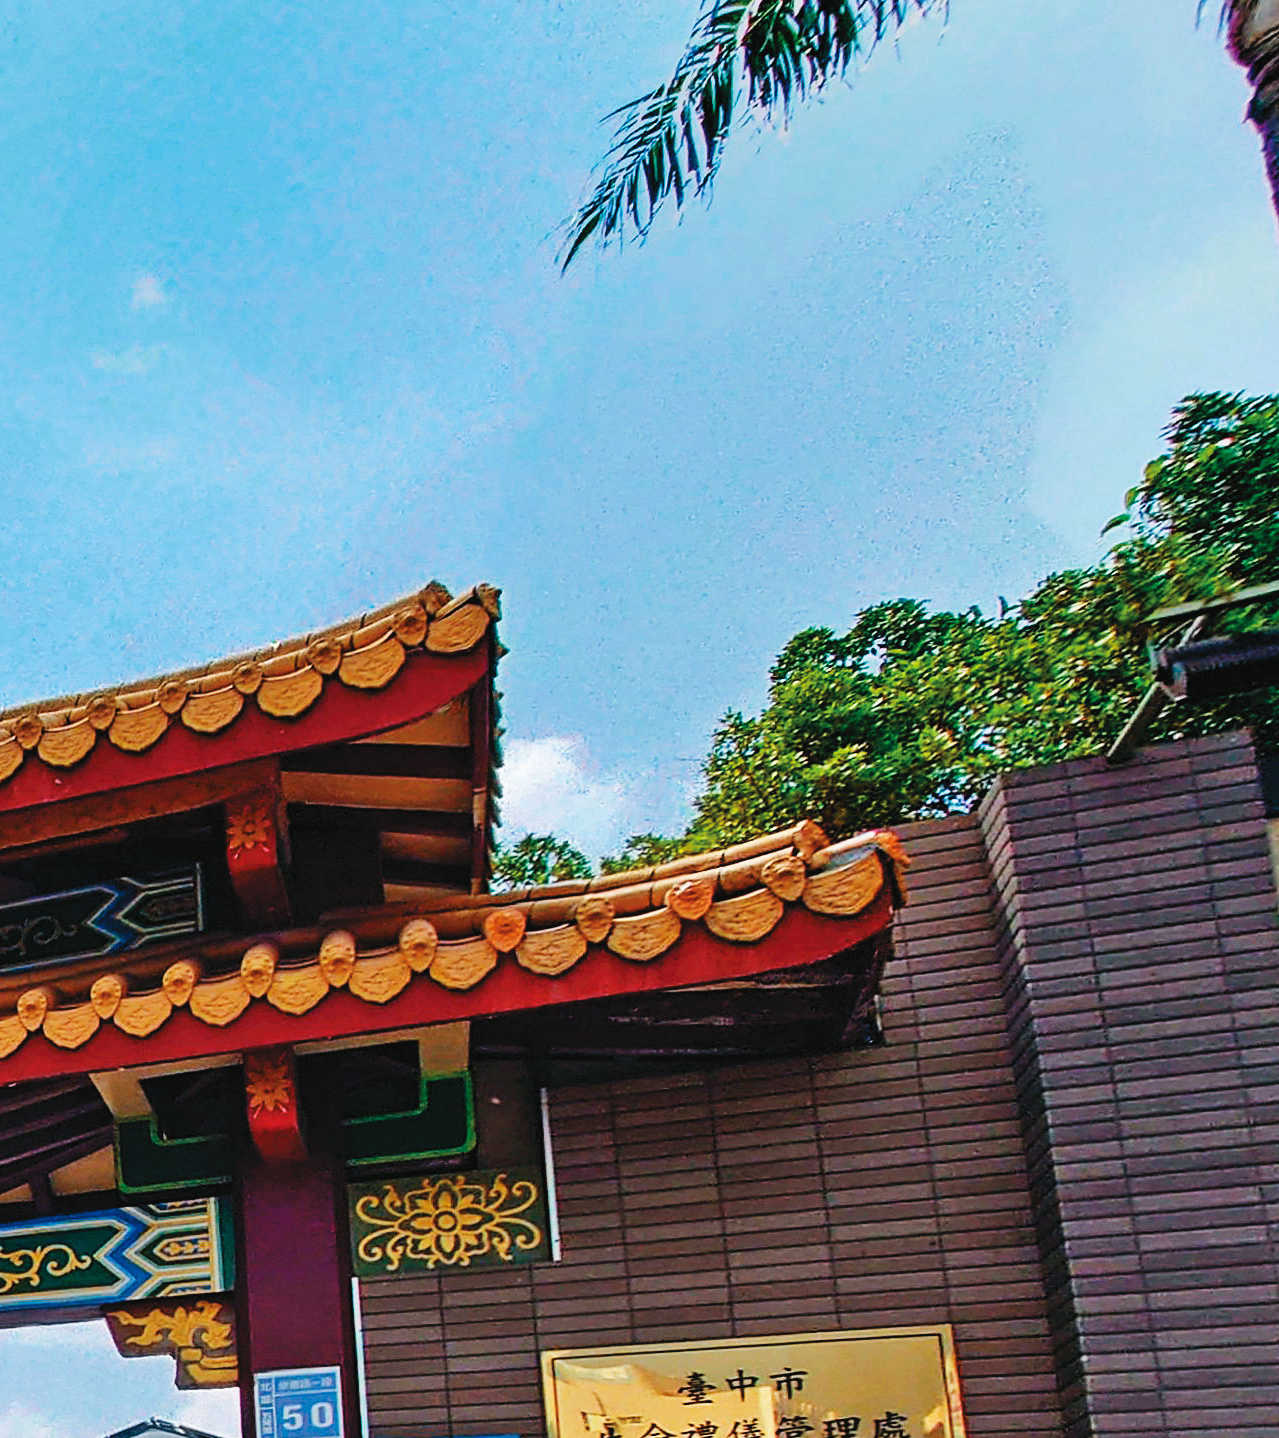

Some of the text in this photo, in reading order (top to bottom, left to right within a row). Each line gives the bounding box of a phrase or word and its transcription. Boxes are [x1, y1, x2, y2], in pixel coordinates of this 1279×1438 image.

[677, 1367, 809, 1406] 臺中市
[282, 1401, 335, 1431] 50
